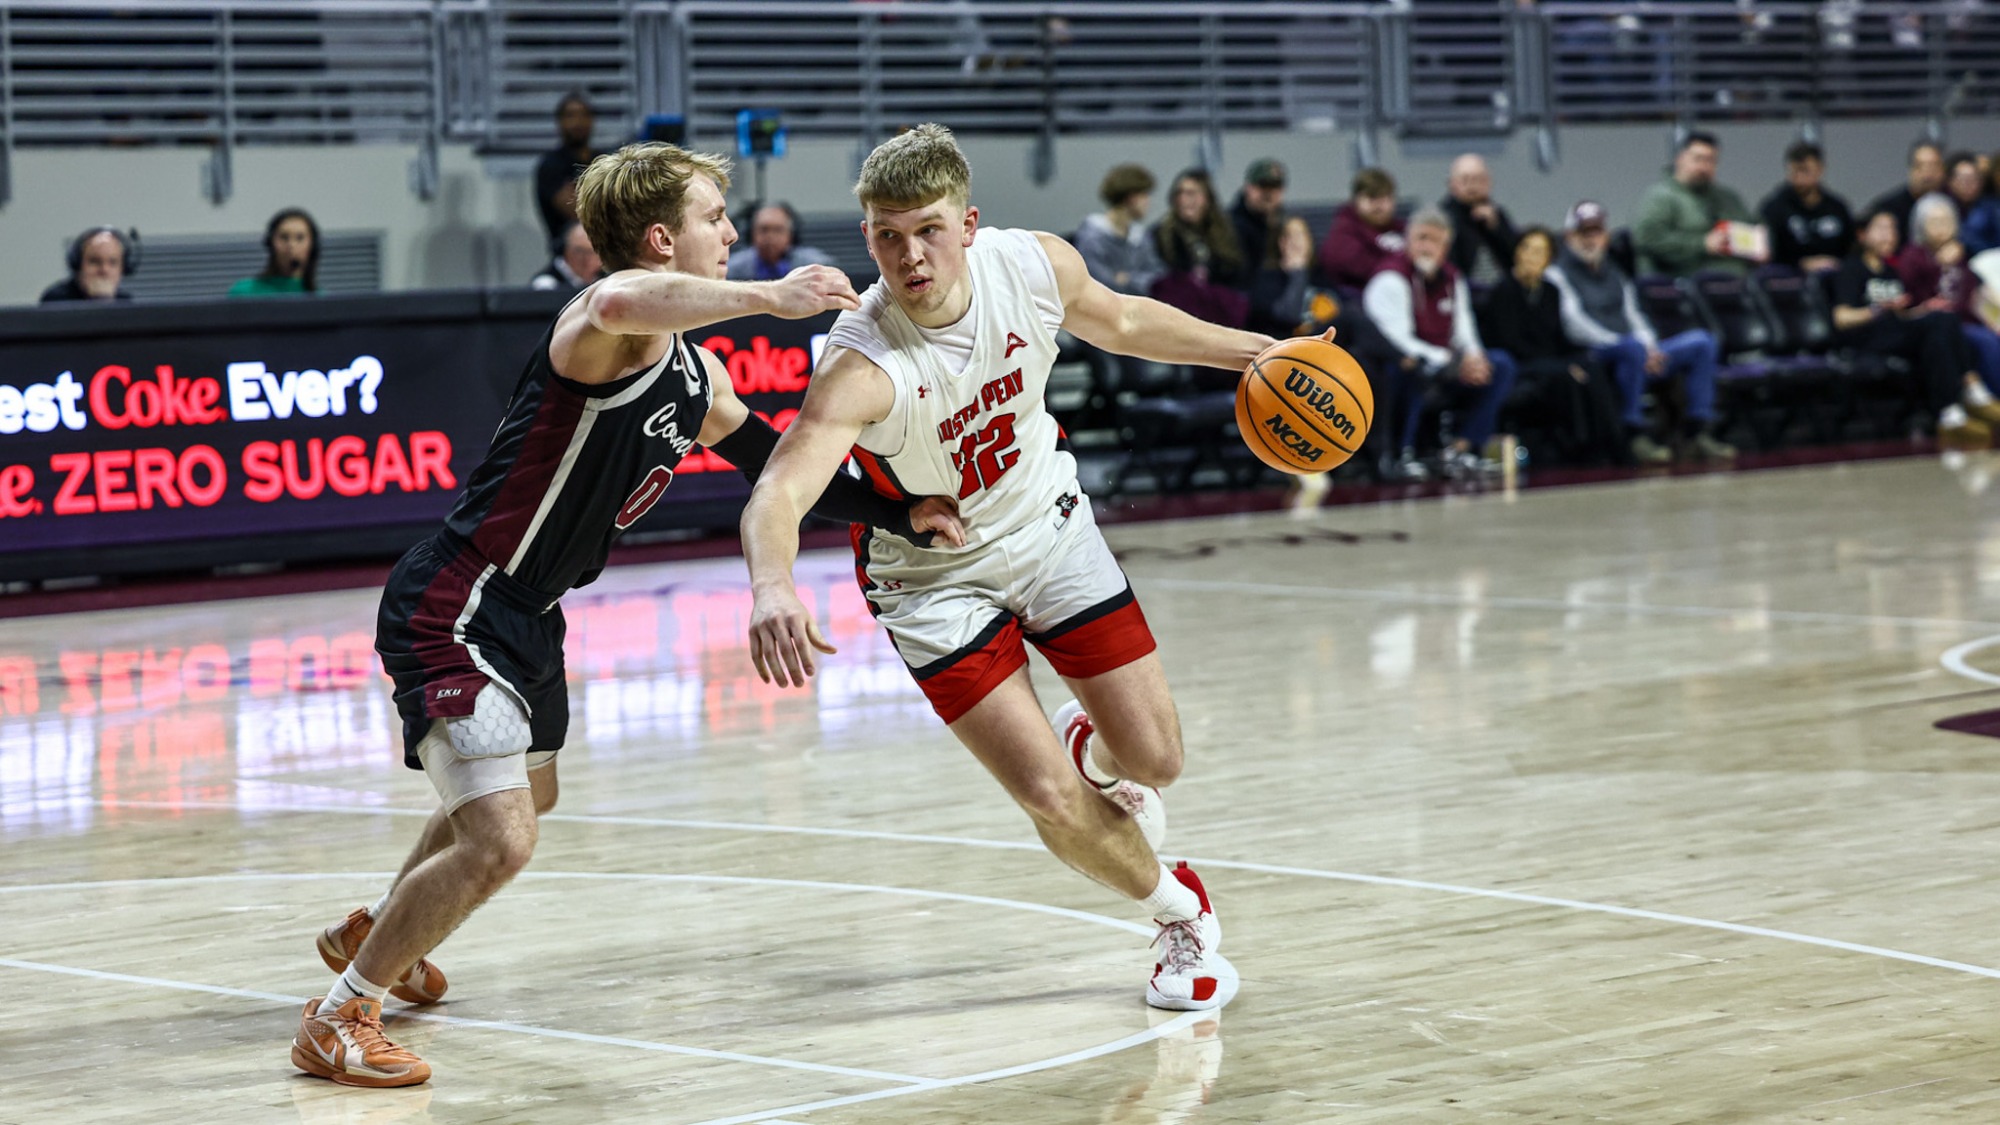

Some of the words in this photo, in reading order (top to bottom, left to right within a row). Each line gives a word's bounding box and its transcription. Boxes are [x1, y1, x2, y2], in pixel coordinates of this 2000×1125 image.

[89, 365, 224, 430] Coke
[227, 355, 384, 421] Ever?
[981, 367, 1024, 412] PEAY
[1284, 367, 1356, 441] Wilson
[1265, 413, 1325, 463] NCAA
[50, 444, 227, 516] ZERO
[241, 431, 457, 502] SUGAR
[615, 464, 674, 530] 0
[436, 688, 462, 700] EKU
